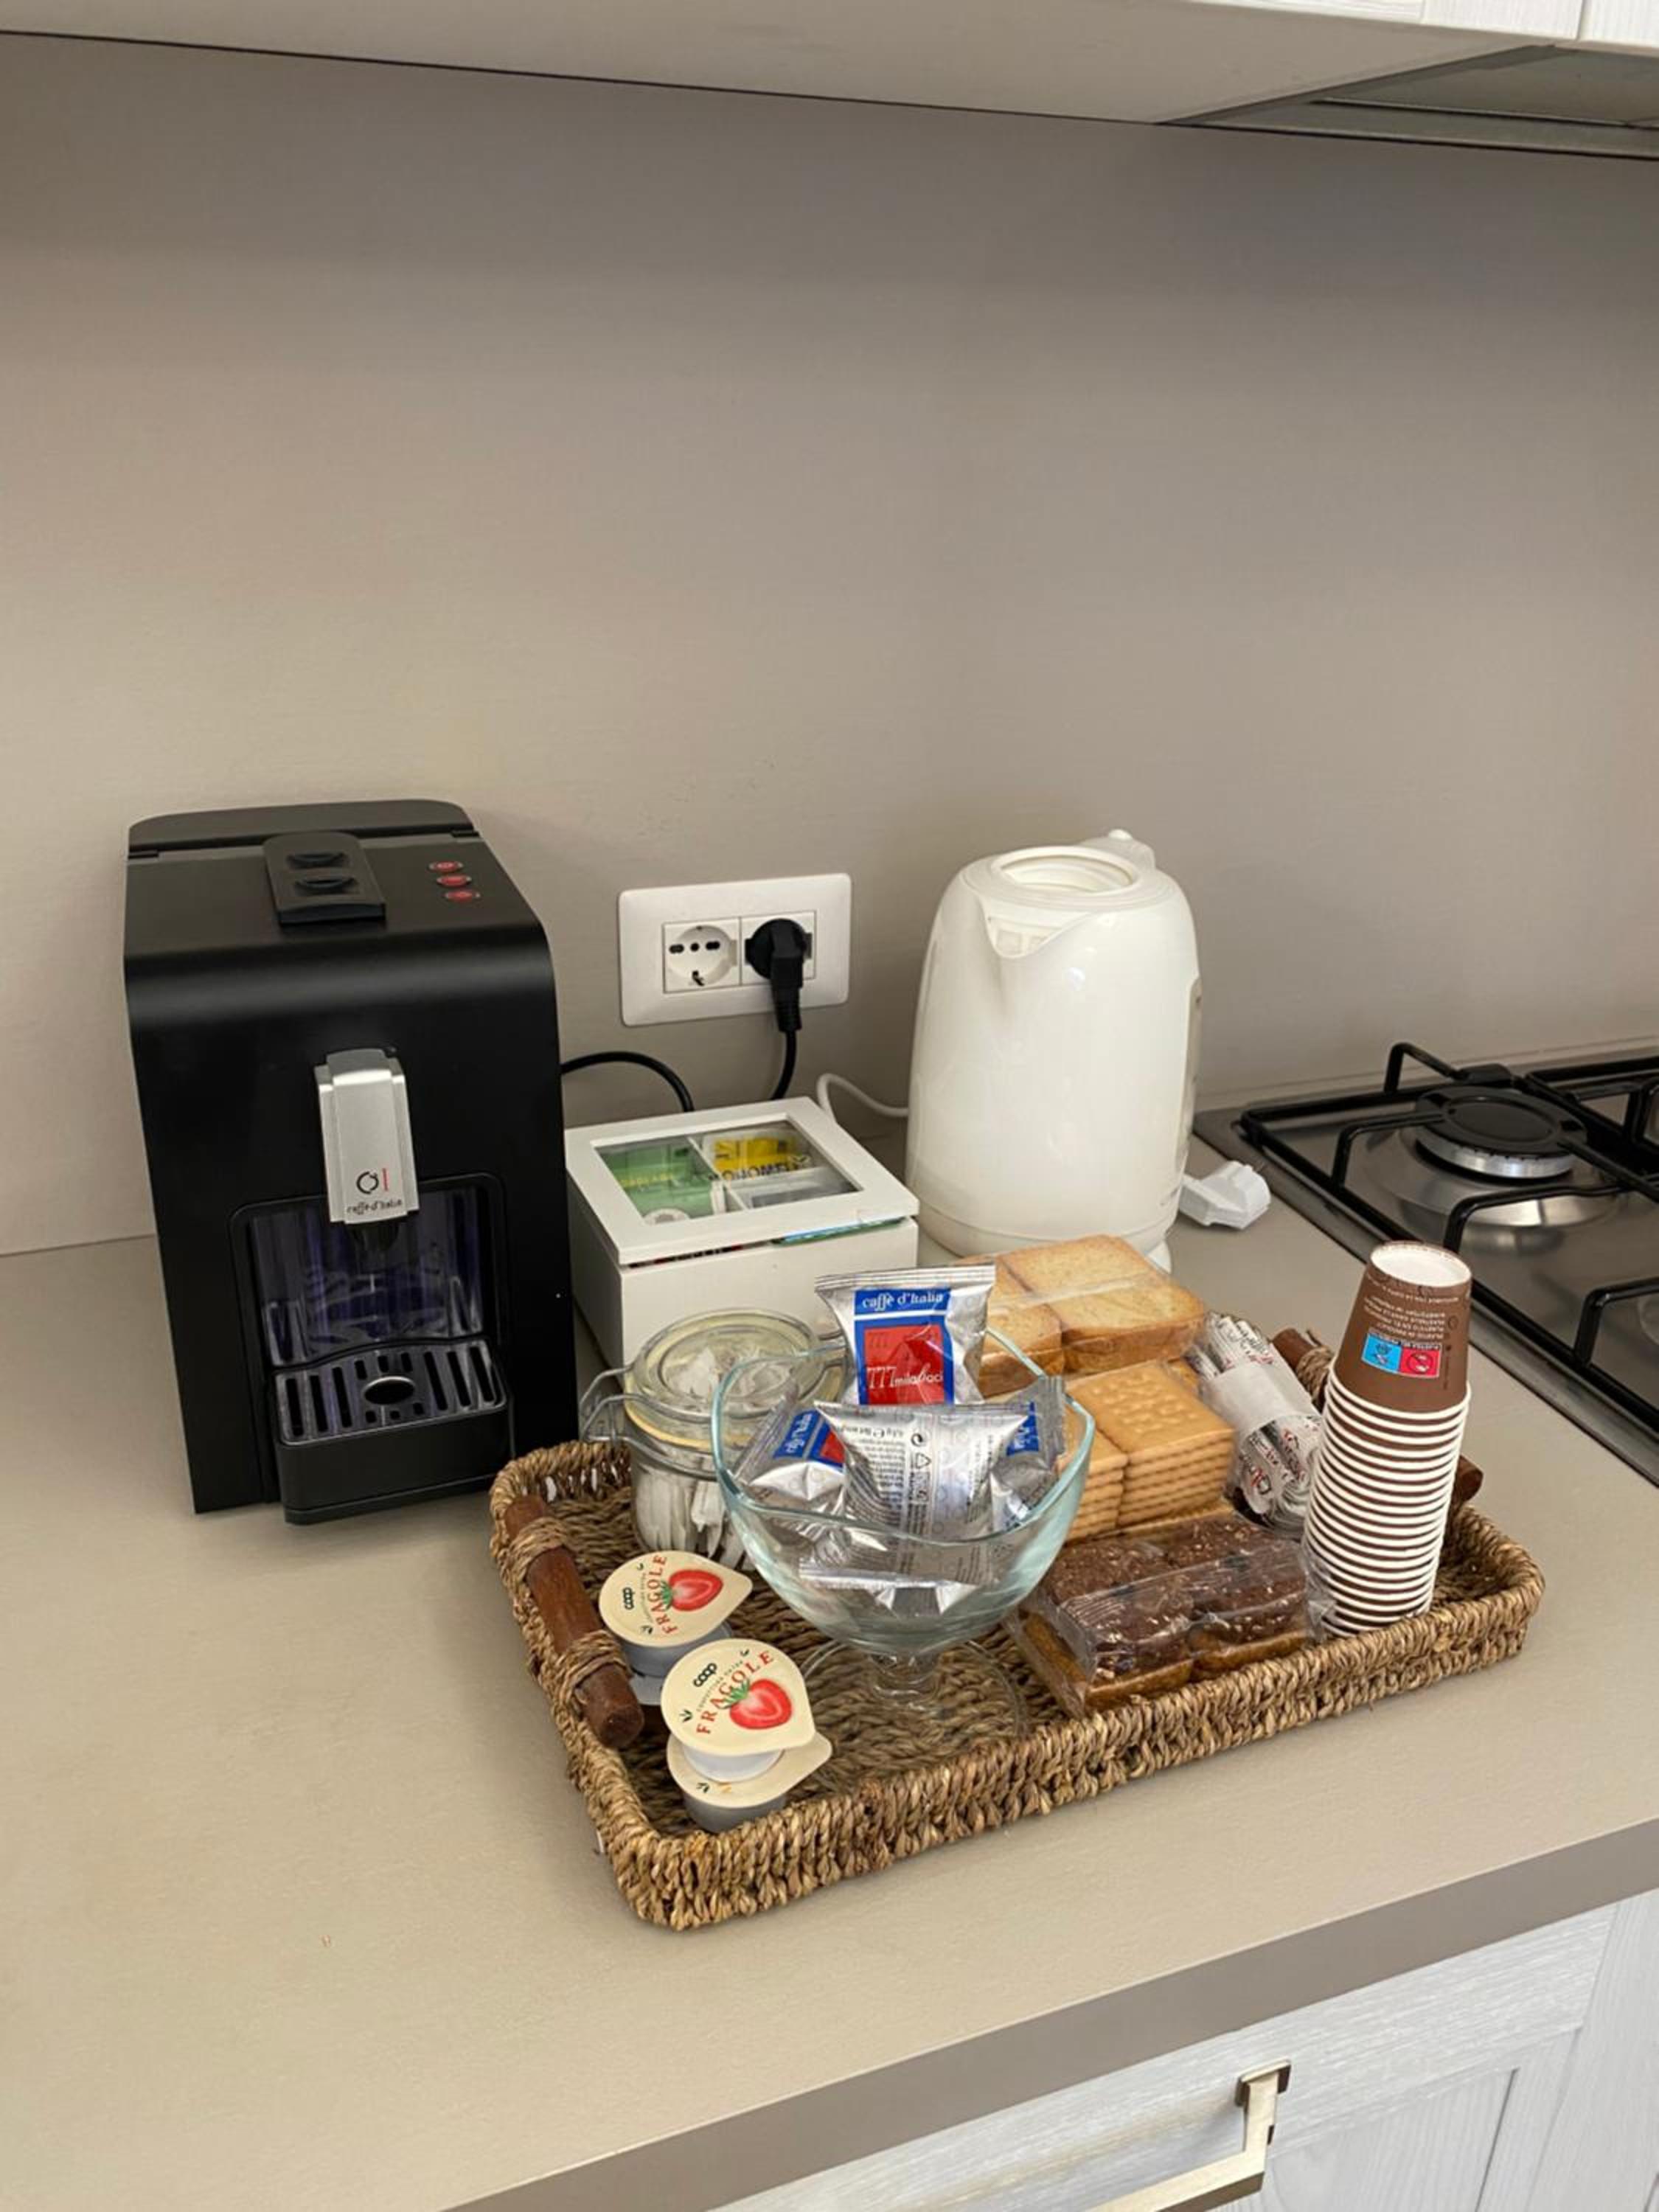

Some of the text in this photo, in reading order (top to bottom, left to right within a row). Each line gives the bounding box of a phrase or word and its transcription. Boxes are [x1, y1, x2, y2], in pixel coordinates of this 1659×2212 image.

[861, 1290, 945, 1312] caffè d'Italia
[622, 1587, 635, 1610] coop
[647, 1555, 678, 1634] FRAGOLE
[692, 1662, 717, 1688] coop
[696, 1649, 774, 1734] FRAGOLE
